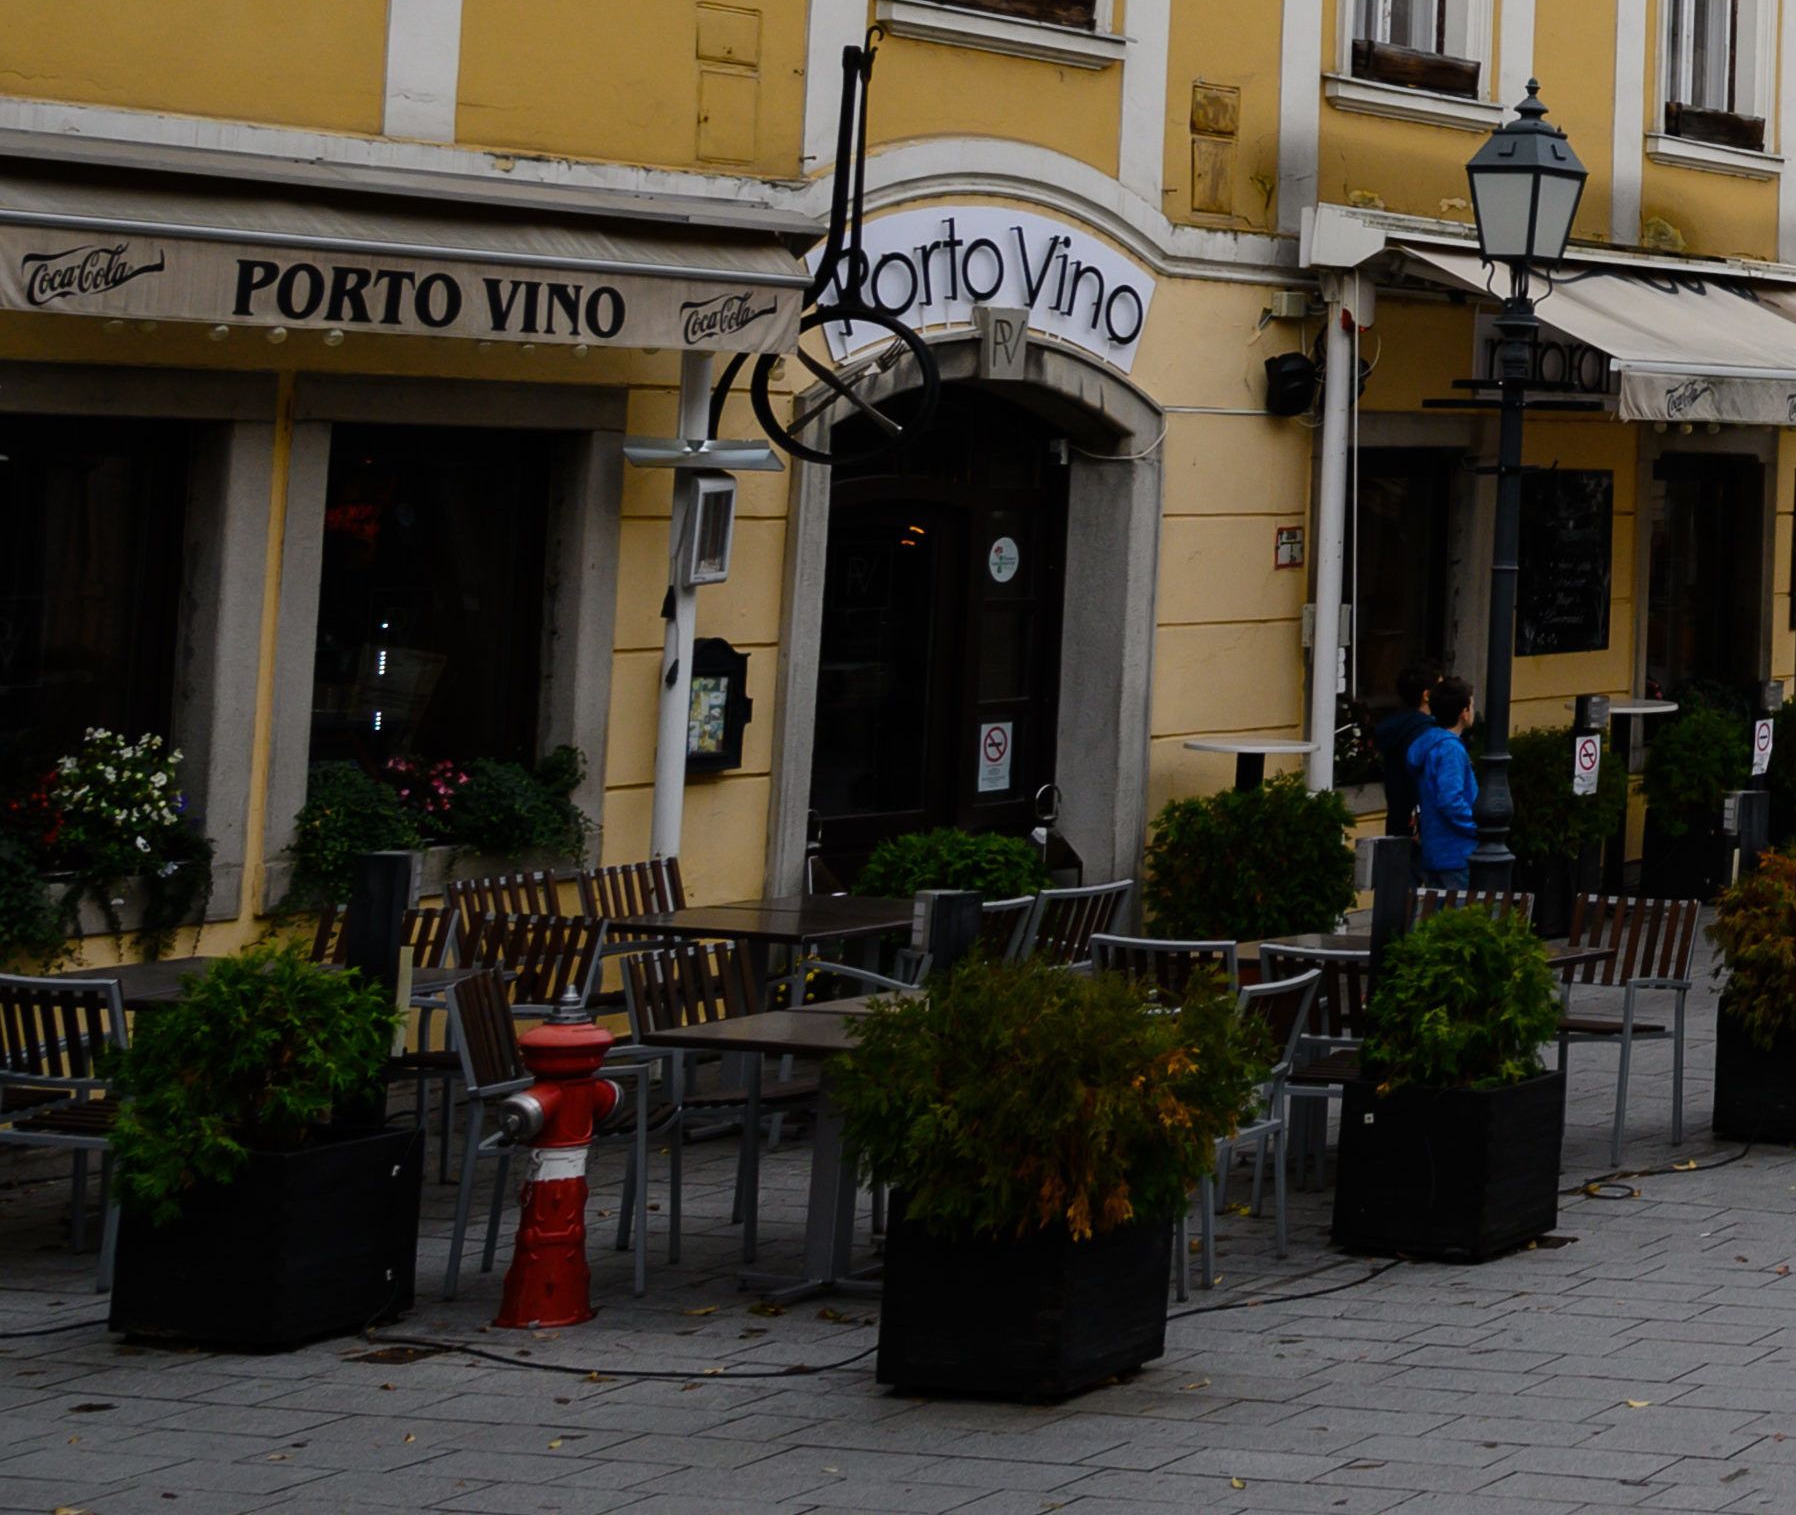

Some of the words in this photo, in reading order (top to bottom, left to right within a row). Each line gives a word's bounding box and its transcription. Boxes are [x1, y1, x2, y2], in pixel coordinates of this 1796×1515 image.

[22, 242, 165, 306] Coca-Cola
[232, 259, 462, 327] PORTO
[482, 278, 626, 339] VINO
[1010, 226, 1143, 345] Vino
[680, 291, 778, 345] Coca-Cola
